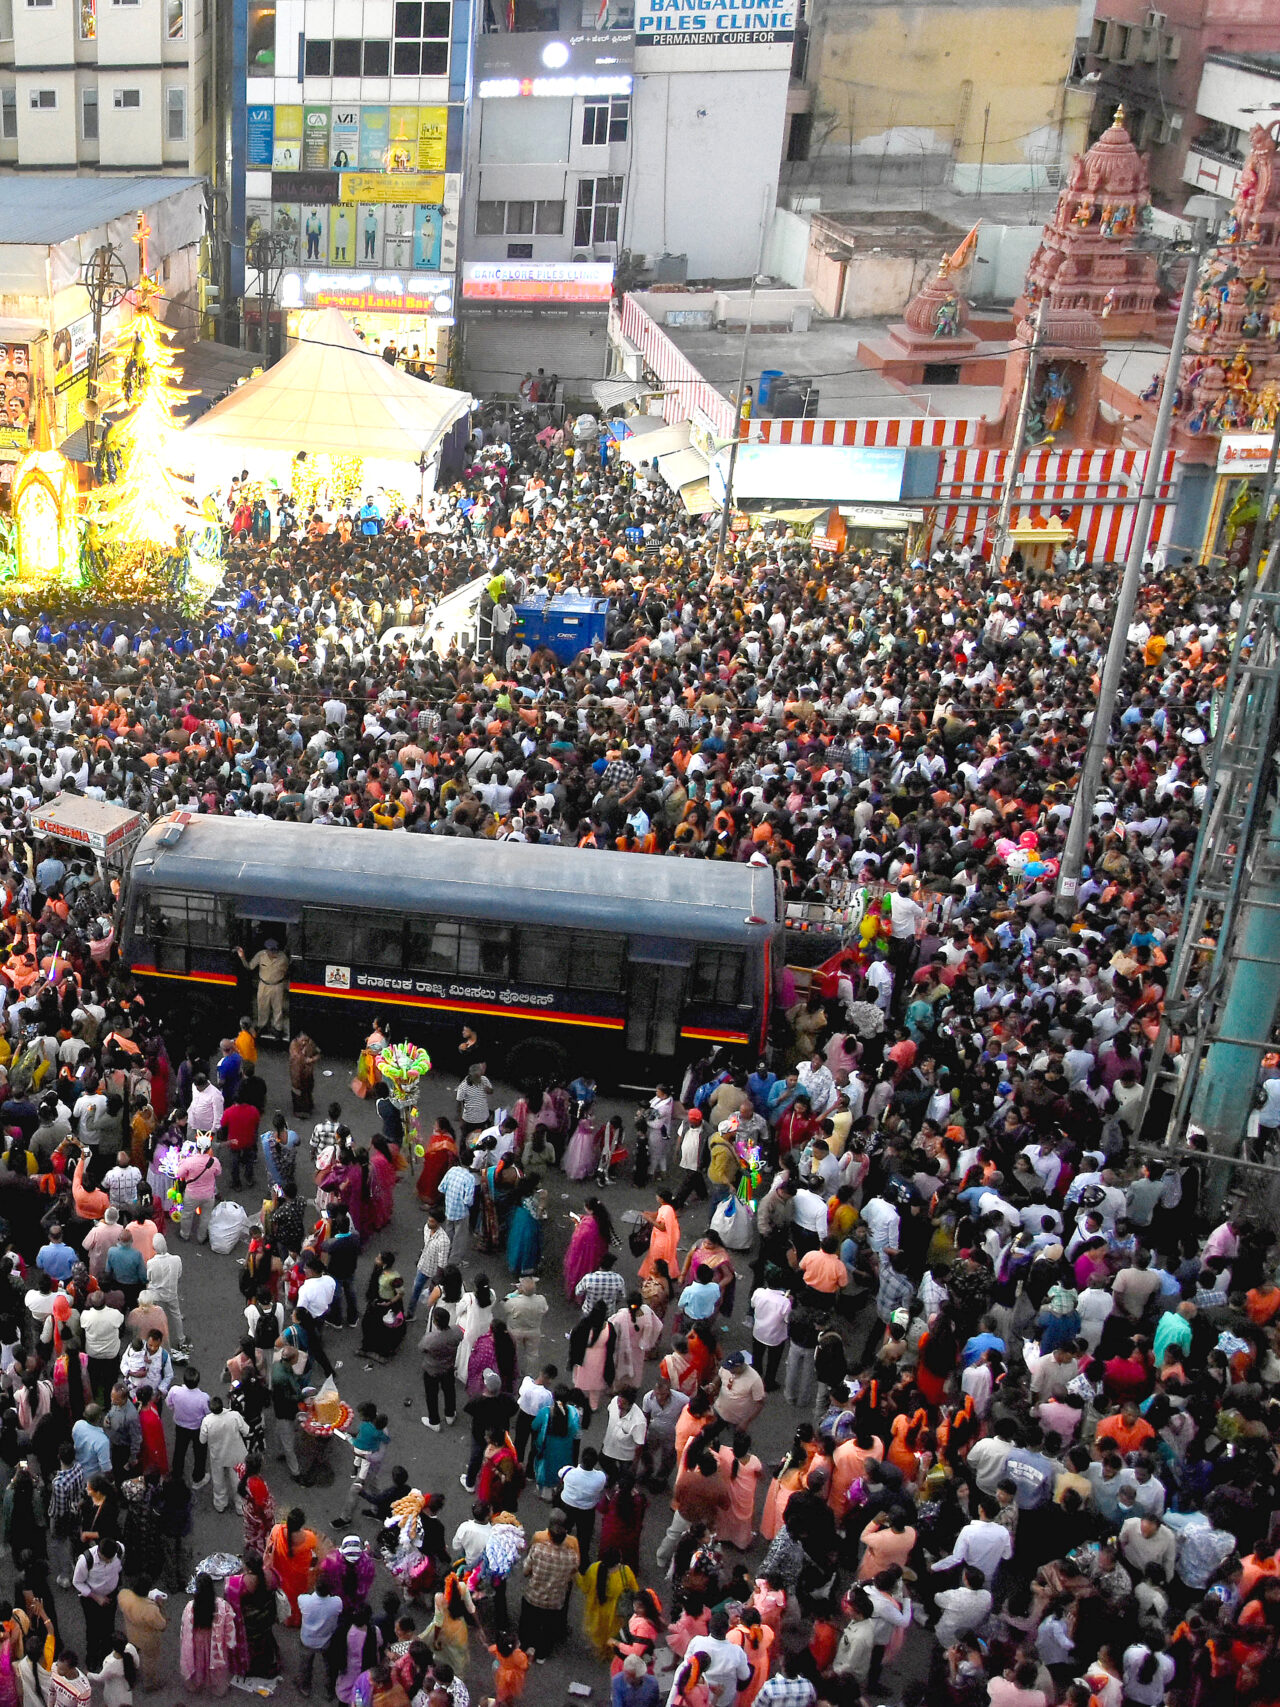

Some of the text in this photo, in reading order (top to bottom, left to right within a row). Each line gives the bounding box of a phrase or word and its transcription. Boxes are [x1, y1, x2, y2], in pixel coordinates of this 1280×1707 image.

[650, 0, 784, 11] BANGALORE
[639, 13, 793, 31] PILES CLINIC
[653, 32, 775, 45] PERMANENT CURE FOR
[475, 269, 600, 280] BANGALORE PILES CLINIC
[317, 292, 432, 309] Sreeraj Lassi Bar
[853, 507, 884, 515] dea
[357, 973, 412, 990] ಕರ್ನಾಟಕ
[416, 982, 446, 998] ರಾಜ್ಯ
[449, 984, 495, 1000] ಮೀಸಲು
